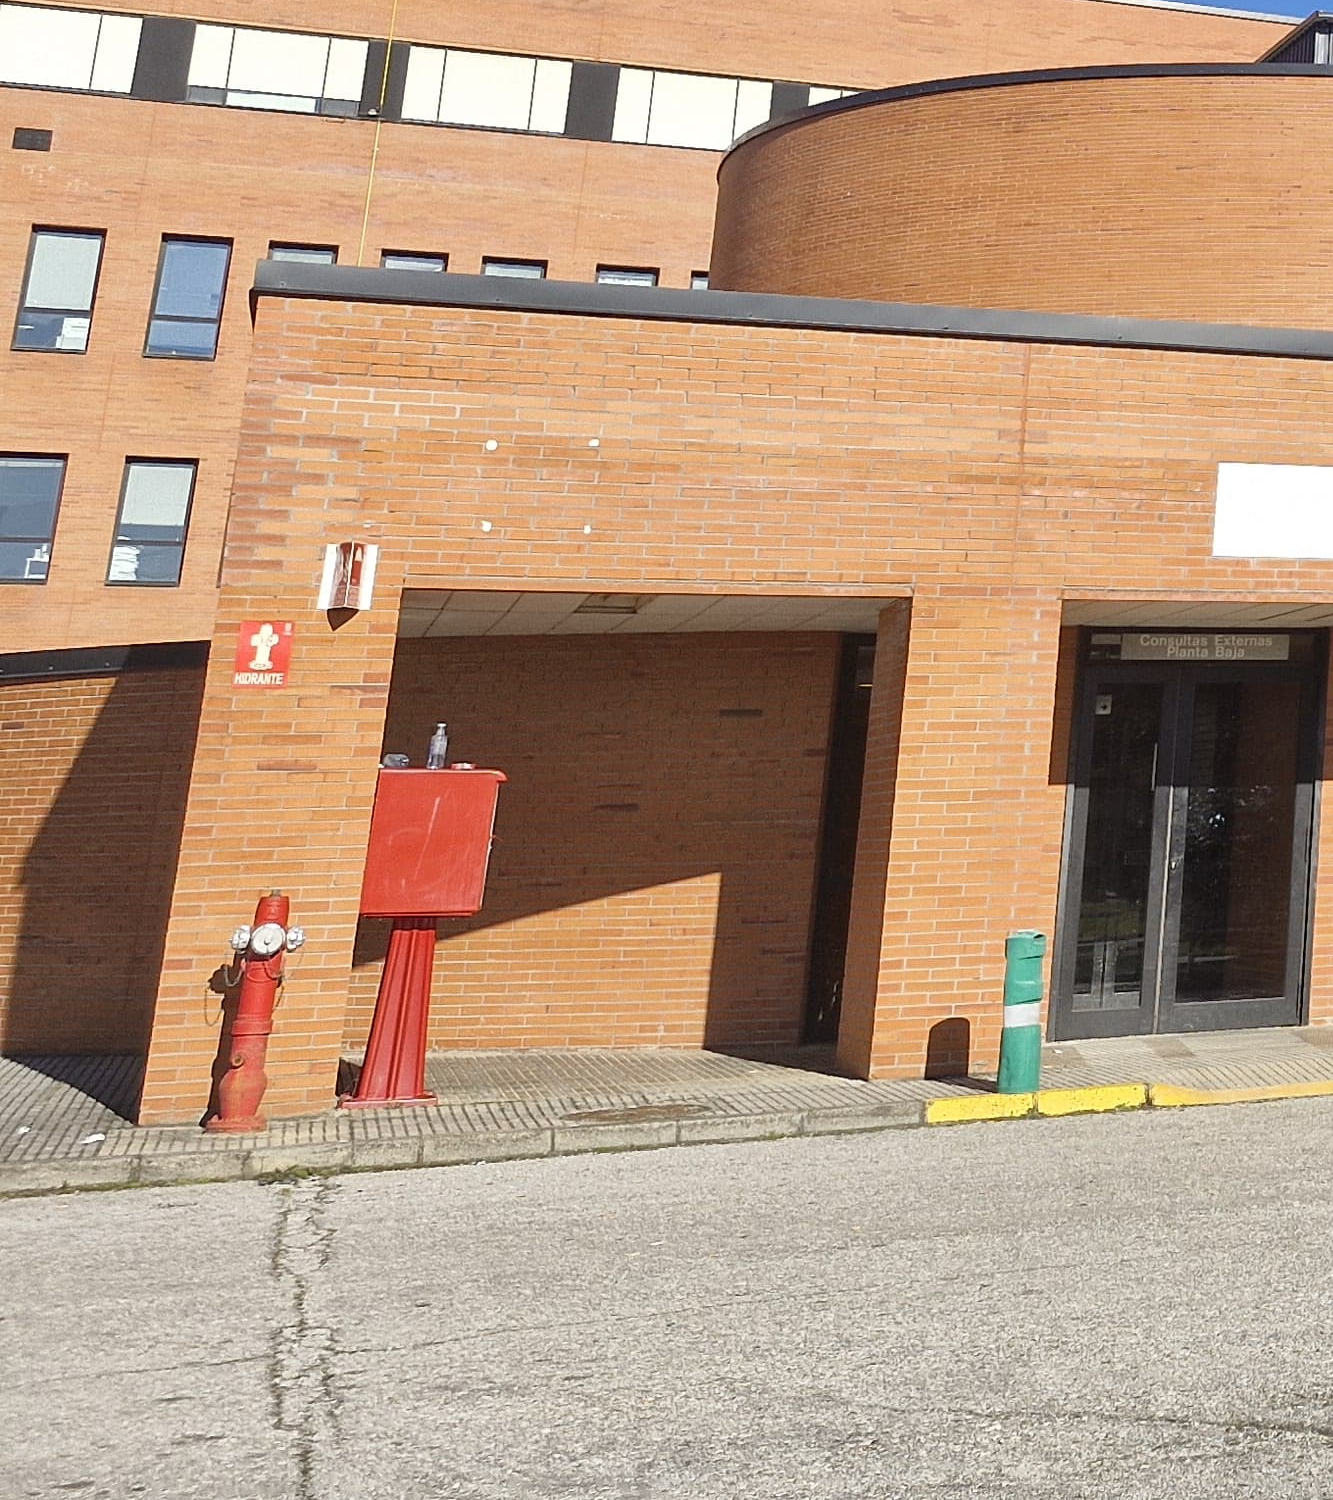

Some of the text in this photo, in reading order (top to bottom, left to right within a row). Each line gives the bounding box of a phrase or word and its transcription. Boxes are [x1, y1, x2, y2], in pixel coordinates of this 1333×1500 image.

[1140, 635, 1272, 647] Consultas Externas
[1167, 647, 1245, 659] Planta Baja
[233, 672, 284, 685] HIDRANTE
